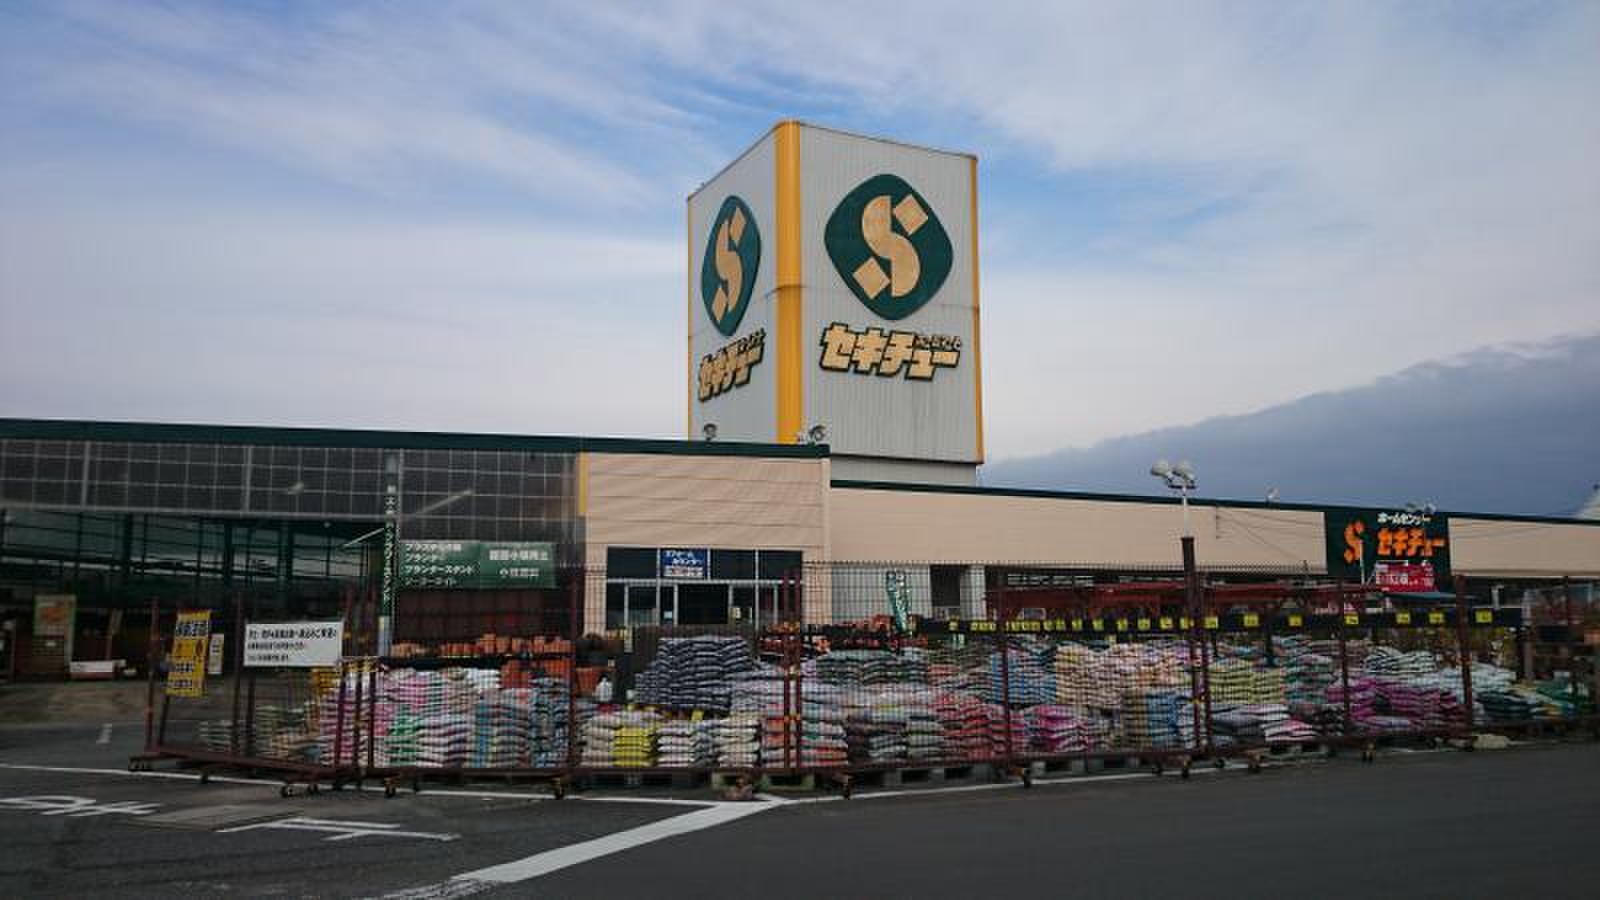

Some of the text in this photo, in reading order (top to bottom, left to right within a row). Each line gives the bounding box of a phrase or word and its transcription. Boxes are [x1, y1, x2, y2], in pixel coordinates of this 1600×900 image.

[819, 322, 961, 382] セキチュー
[1377, 527, 1446, 557] セキチュー
